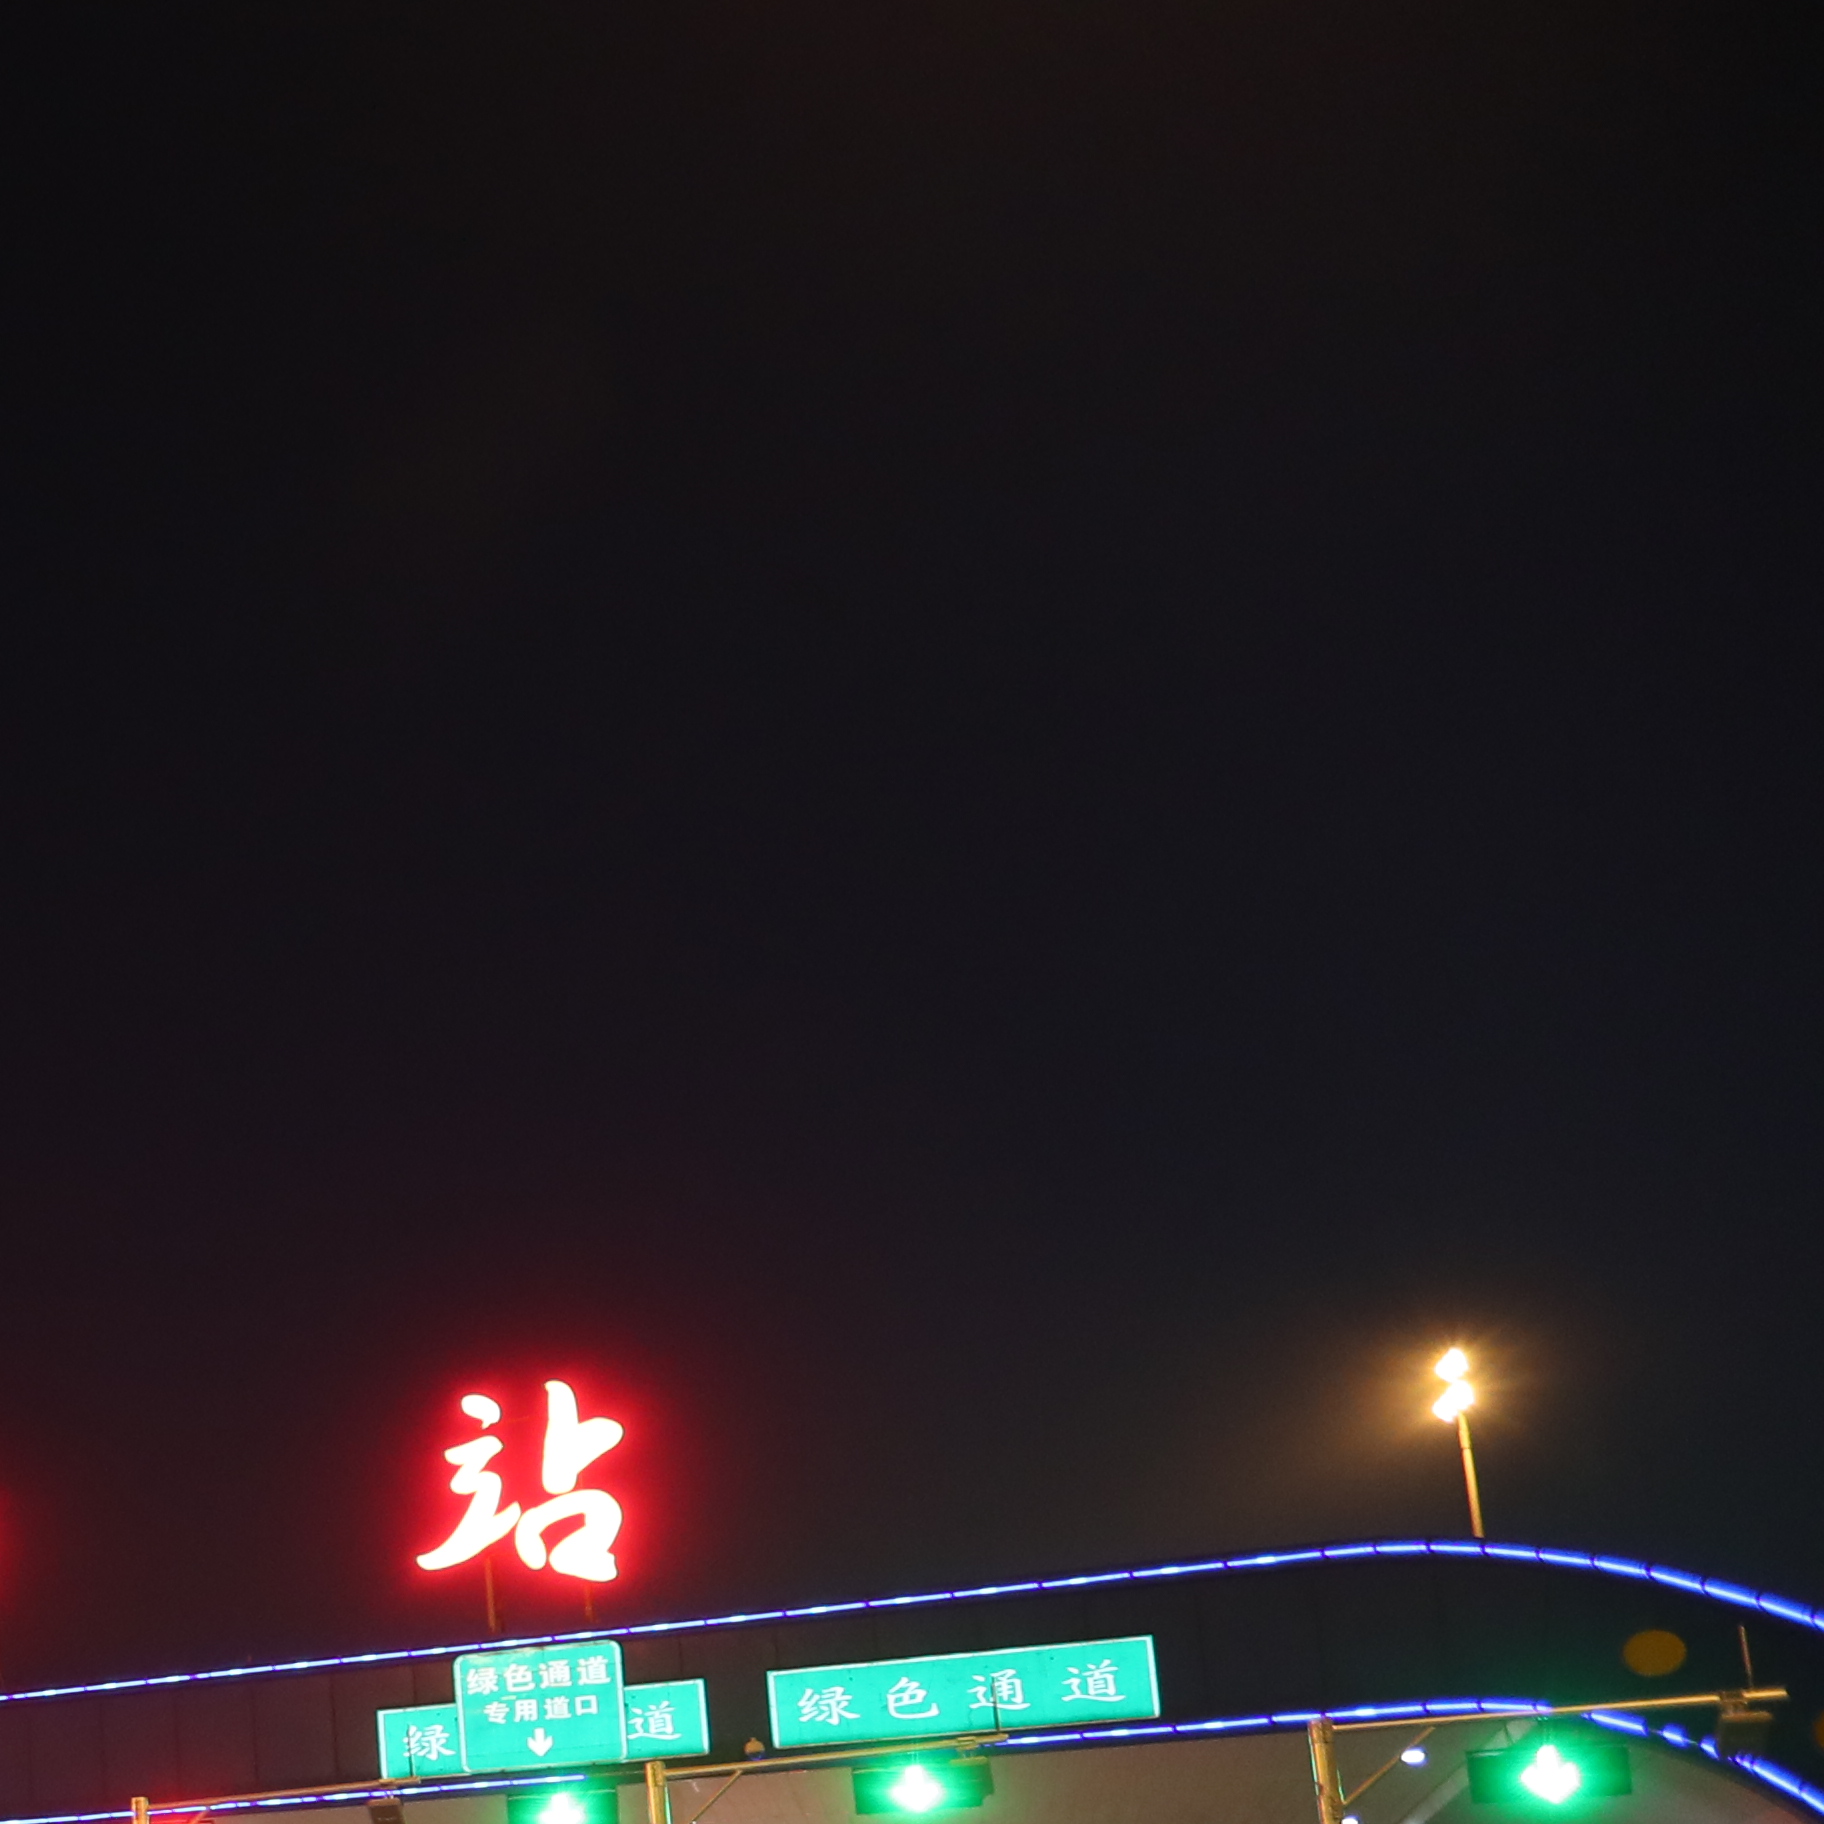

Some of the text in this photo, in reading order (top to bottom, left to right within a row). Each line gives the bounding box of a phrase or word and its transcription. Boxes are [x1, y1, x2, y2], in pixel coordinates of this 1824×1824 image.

[465, 1654, 612, 1696] 绿色通道
[796, 1658, 1127, 1727] 绿色通道
[483, 1693, 600, 1725] 专用道口
